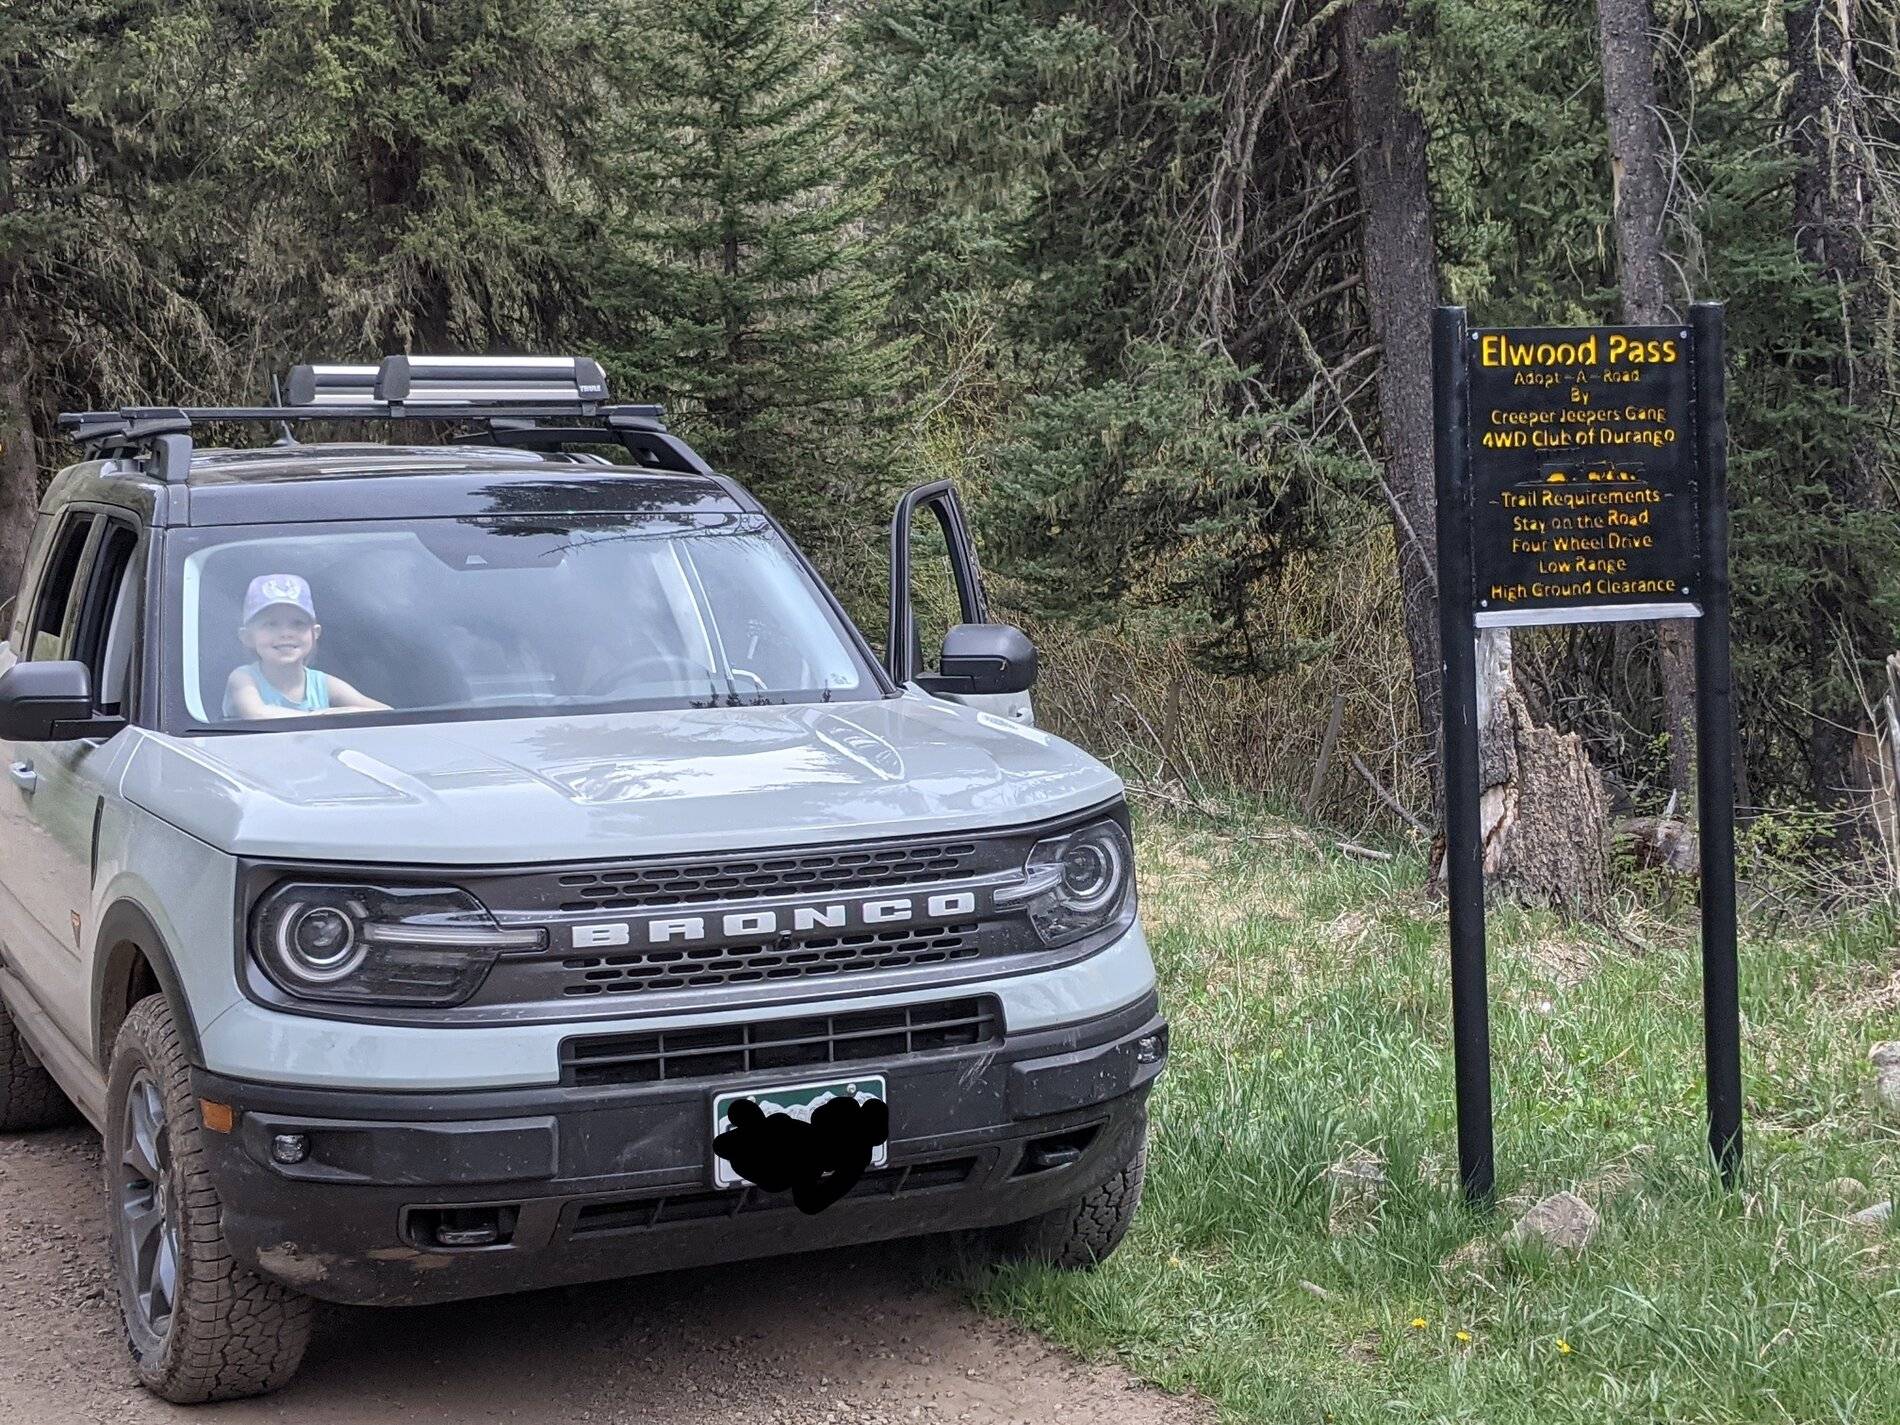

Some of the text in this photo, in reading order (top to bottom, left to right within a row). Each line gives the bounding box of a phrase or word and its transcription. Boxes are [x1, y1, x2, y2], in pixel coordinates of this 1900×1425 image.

[1482, 334, 1676, 366] Elwood Pass
[1571, 386, 1590, 405] By
[1491, 405, 1667, 427] Creeper Jeepers Gang
[1482, 426, 1675, 448] 4WD Club of Durango
[1513, 509, 1649, 533] Stay on the Road
[1512, 532, 1653, 553] Four Wheel Drive
[1539, 556, 1628, 574] Low Range
[1491, 579, 1676, 602] High Ground Clearance
[571, 892, 976, 949] BRONCO
